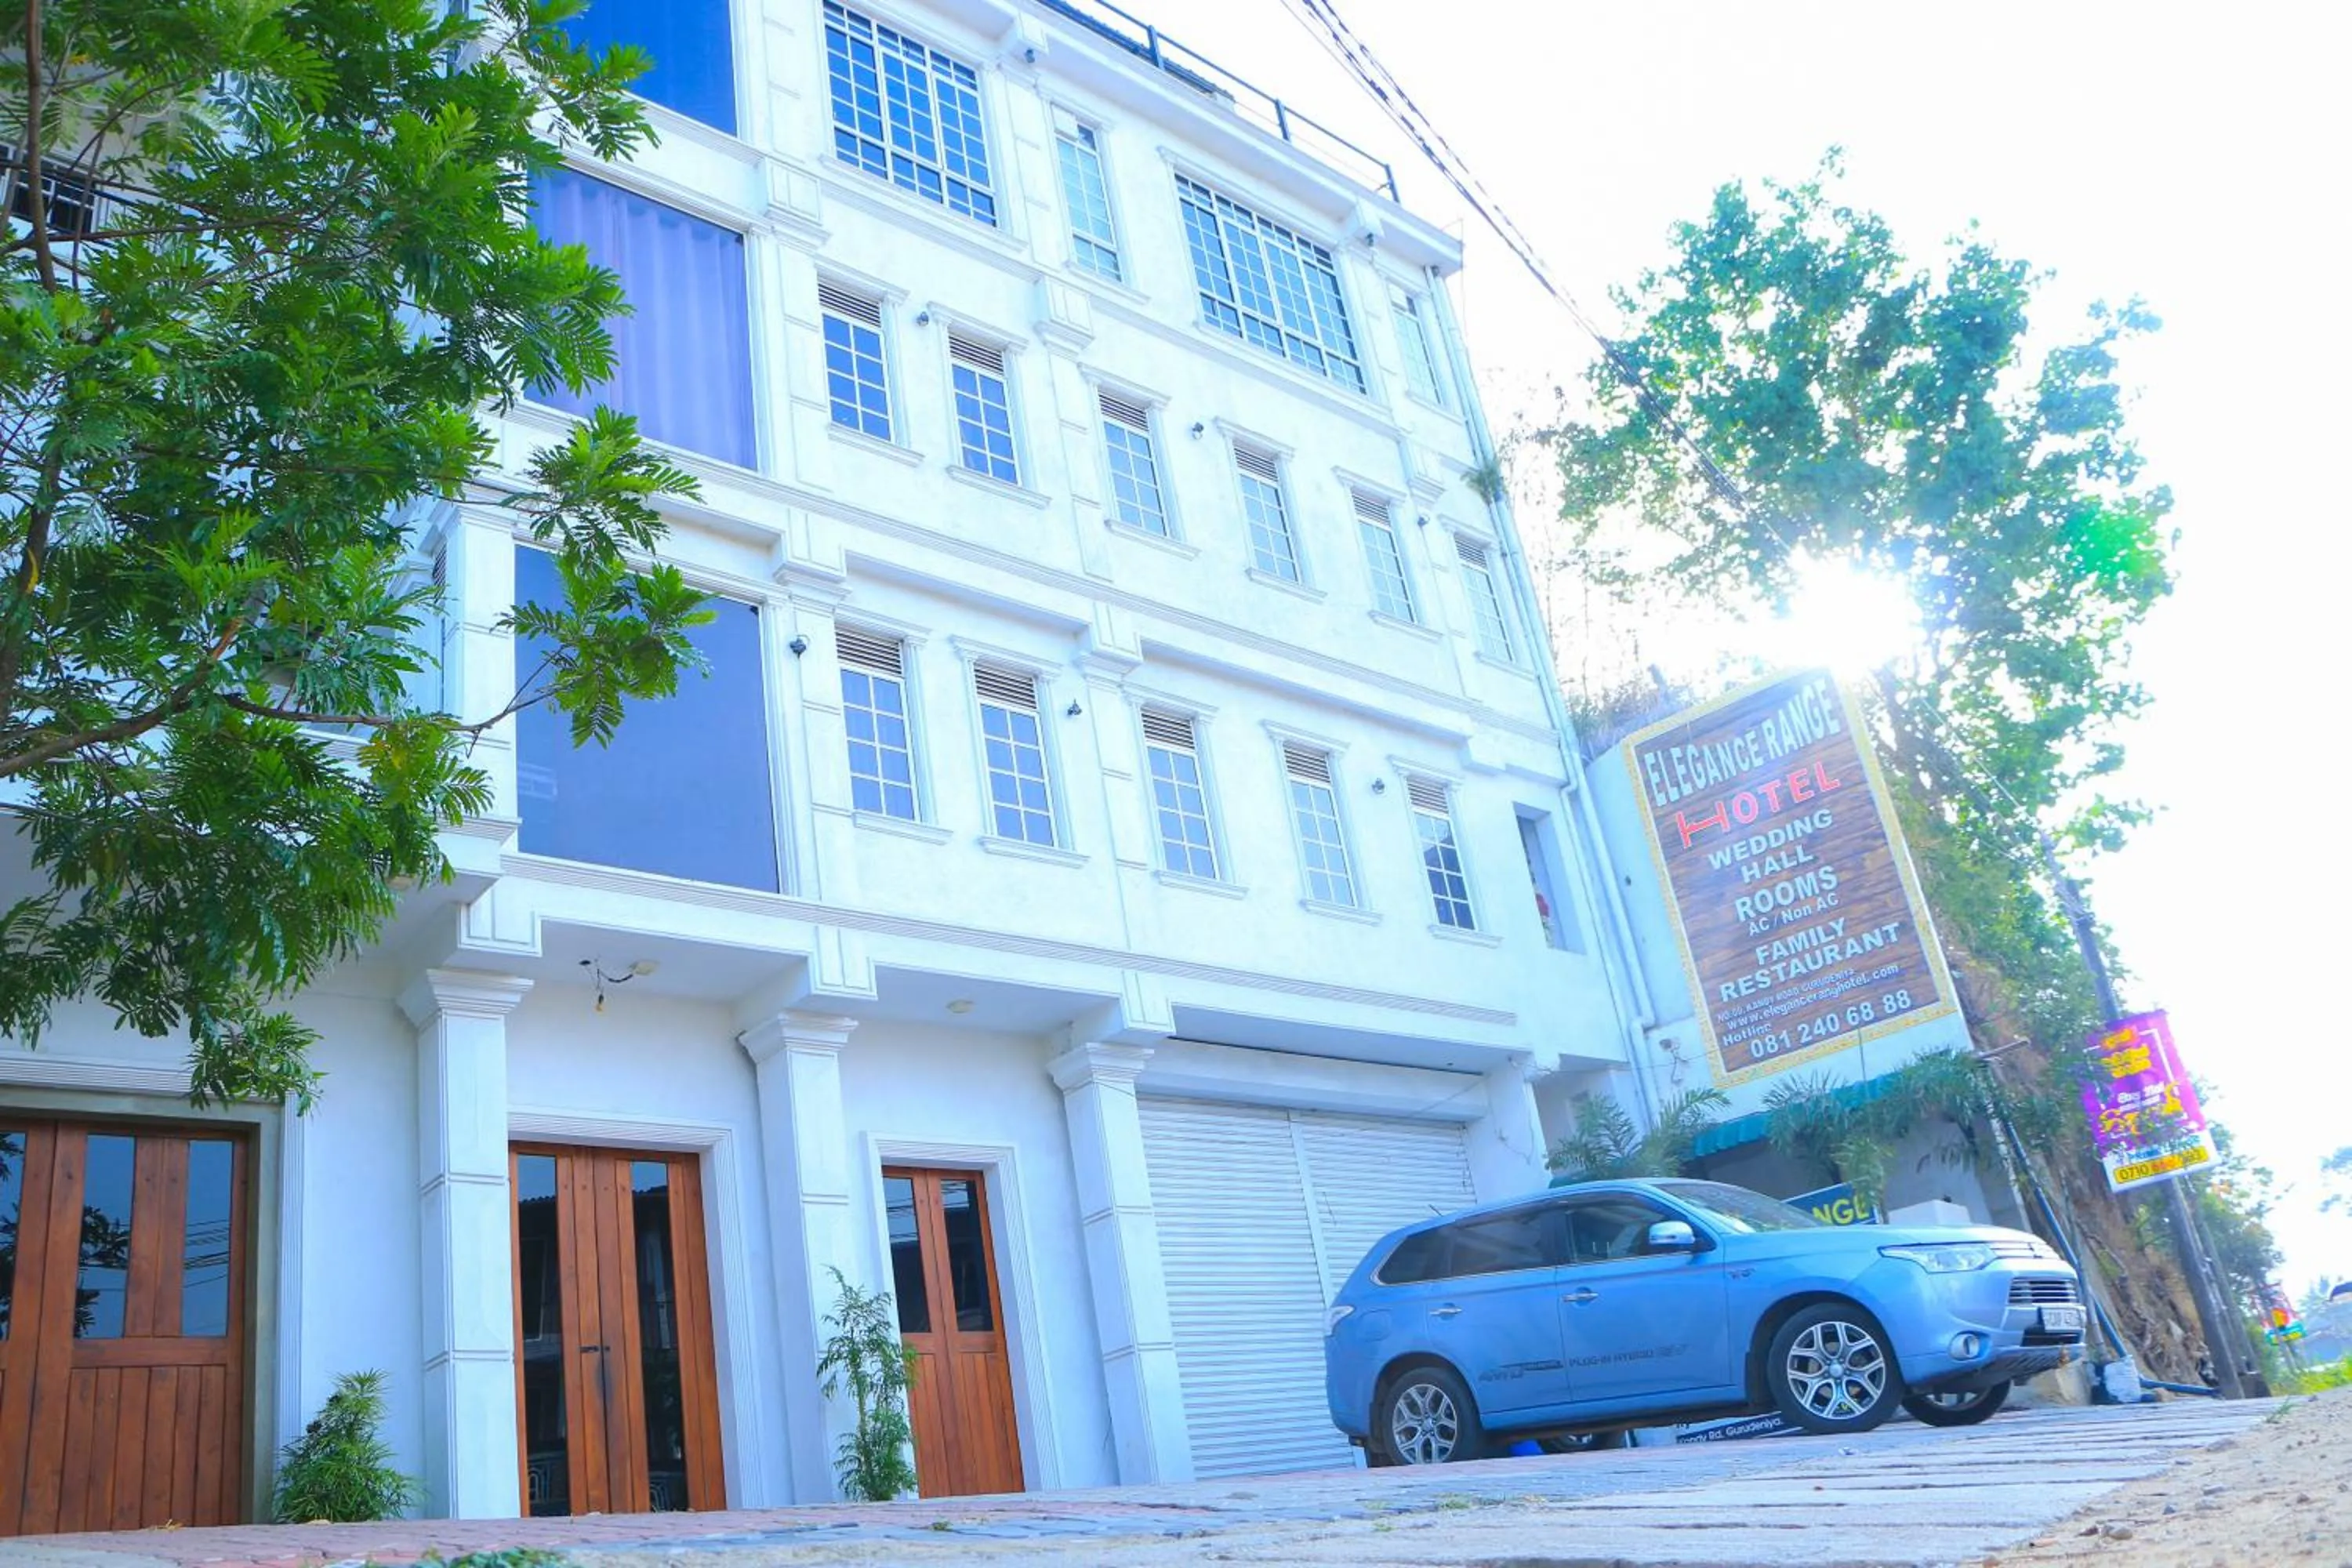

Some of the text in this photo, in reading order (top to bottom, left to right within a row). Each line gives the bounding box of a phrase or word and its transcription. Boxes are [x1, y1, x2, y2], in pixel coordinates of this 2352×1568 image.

[1644, 678, 1842, 807] ELEGANCE RANGE
[1675, 760, 1842, 849] HOTEL
[1708, 808, 1833, 869] WEDDING
[1740, 844, 1813, 884] HALL
[1735, 866, 1838, 922] ROOMS
[1748, 917, 1769, 936] AC
[1781, 904, 1812, 924] Non
[1817, 892, 1838, 912] AC
[1719, 922, 1900, 1002] RESTAURANT
[1755, 917, 1845, 965] FAMILY
[1722, 1023, 1772, 1047] Hotline
[1751, 989, 1911, 1058] 081 240 68 88
